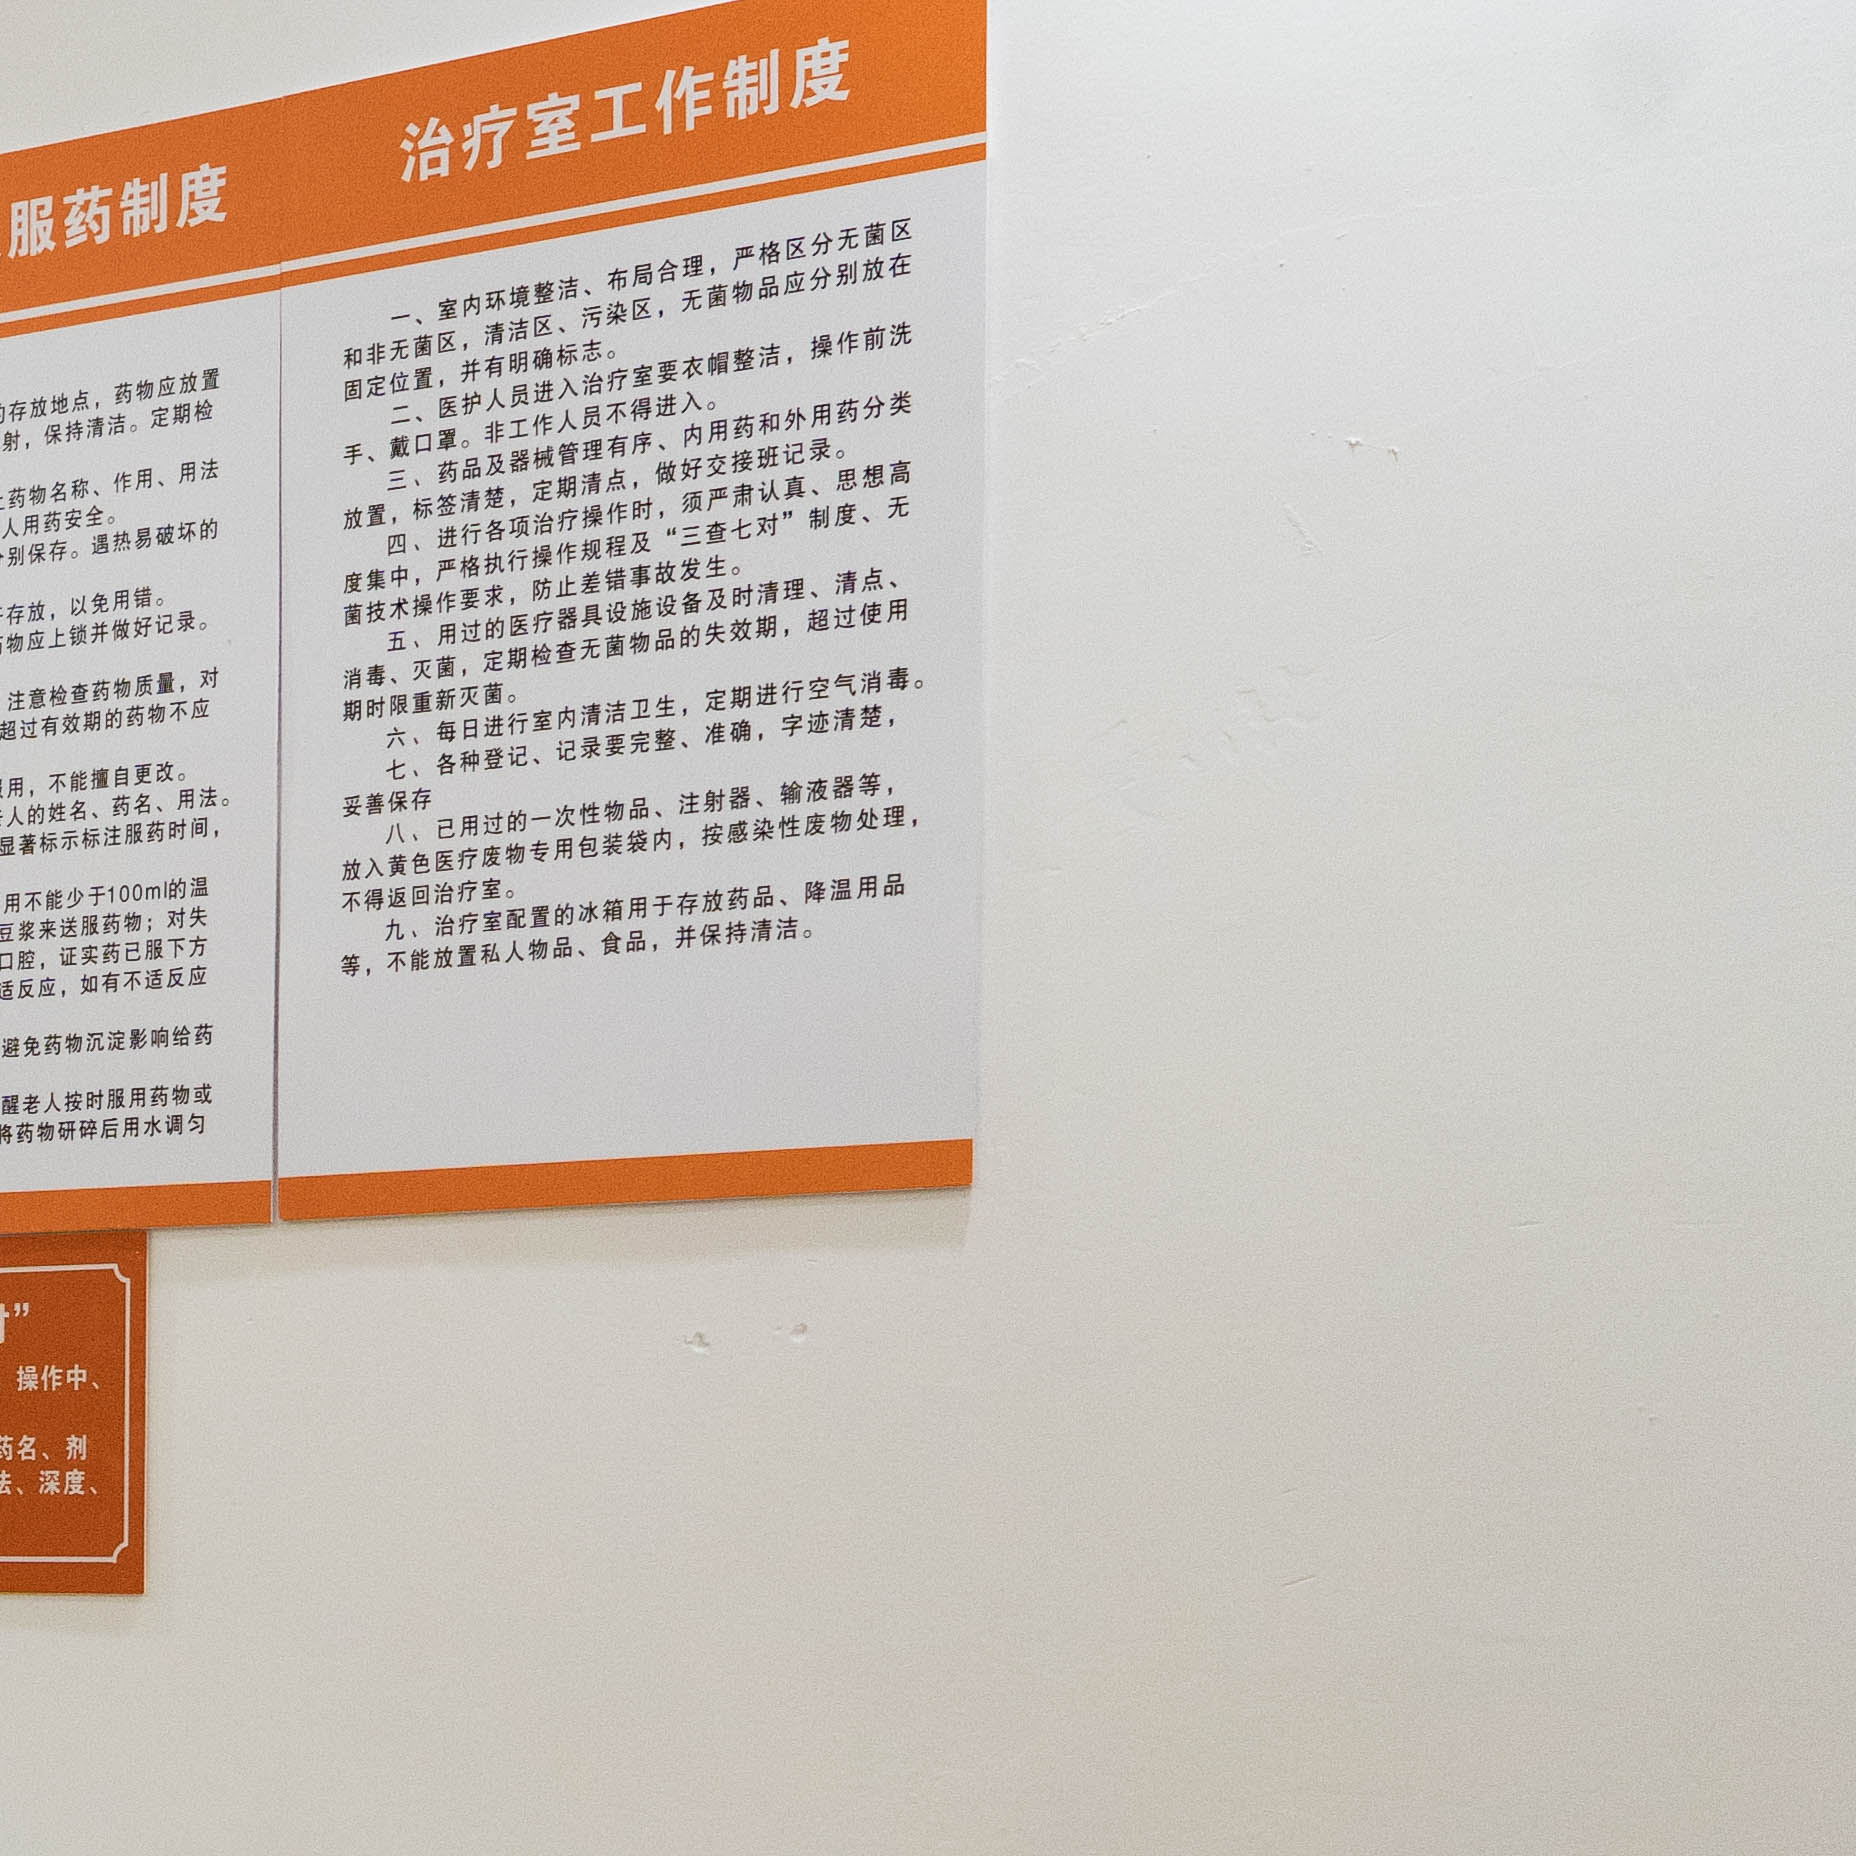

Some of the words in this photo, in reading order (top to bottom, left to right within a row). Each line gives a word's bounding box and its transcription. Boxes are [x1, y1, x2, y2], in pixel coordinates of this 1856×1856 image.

[400, 37, 850, 182] 治疗室工作制度
[342, 337, 620, 403] 固定位置，并有明确标志。
[341, 679, 520, 723] 期时限重新灭菌。
[340, 785, 433, 819] 妥善保存
[340, 875, 518, 914] 不得返回治疗室。
